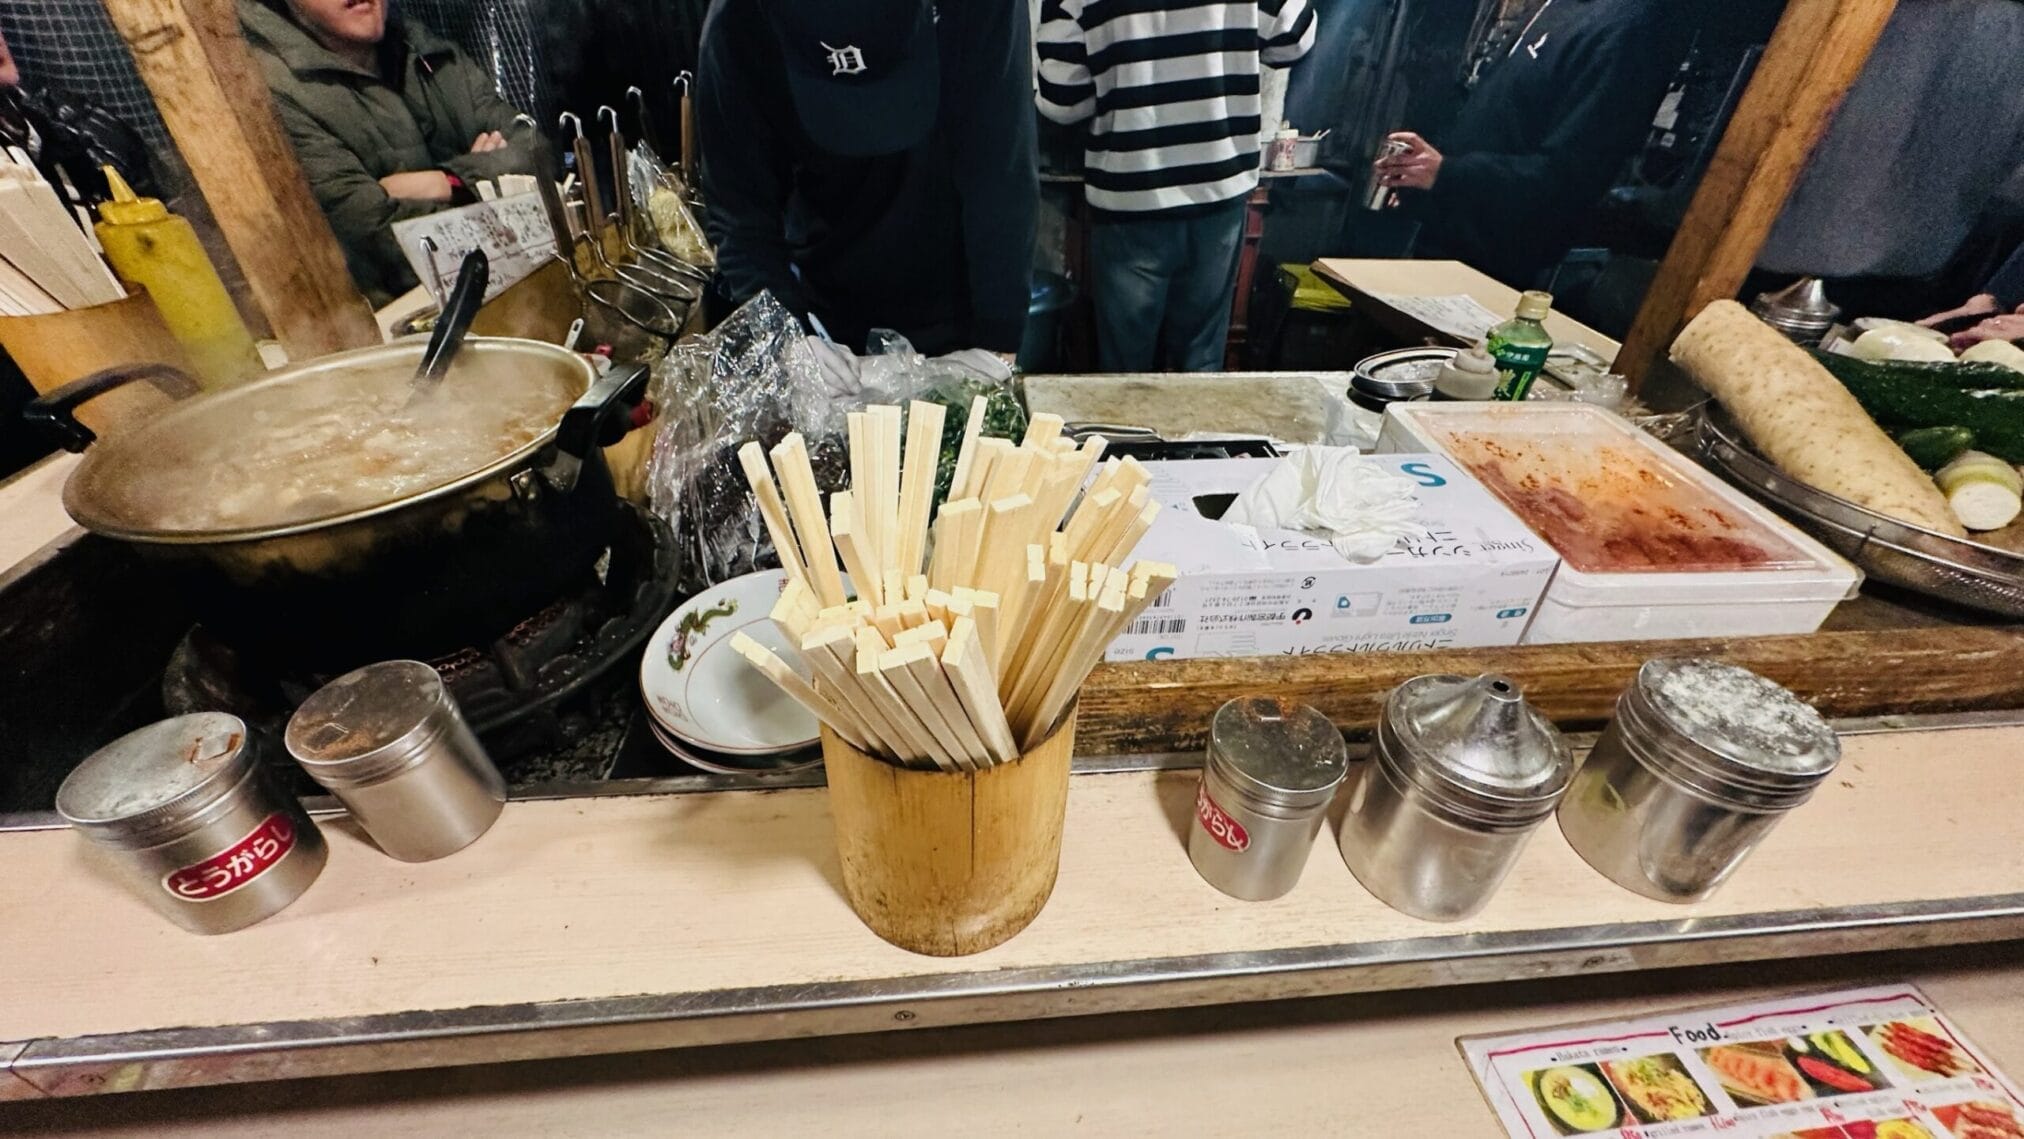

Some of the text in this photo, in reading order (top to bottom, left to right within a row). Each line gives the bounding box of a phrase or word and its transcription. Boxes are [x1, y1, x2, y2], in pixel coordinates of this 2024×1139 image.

[820, 40, 868, 76] D
[1400, 462, 1447, 487] S
[177, 825, 291, 895] とうがらし
